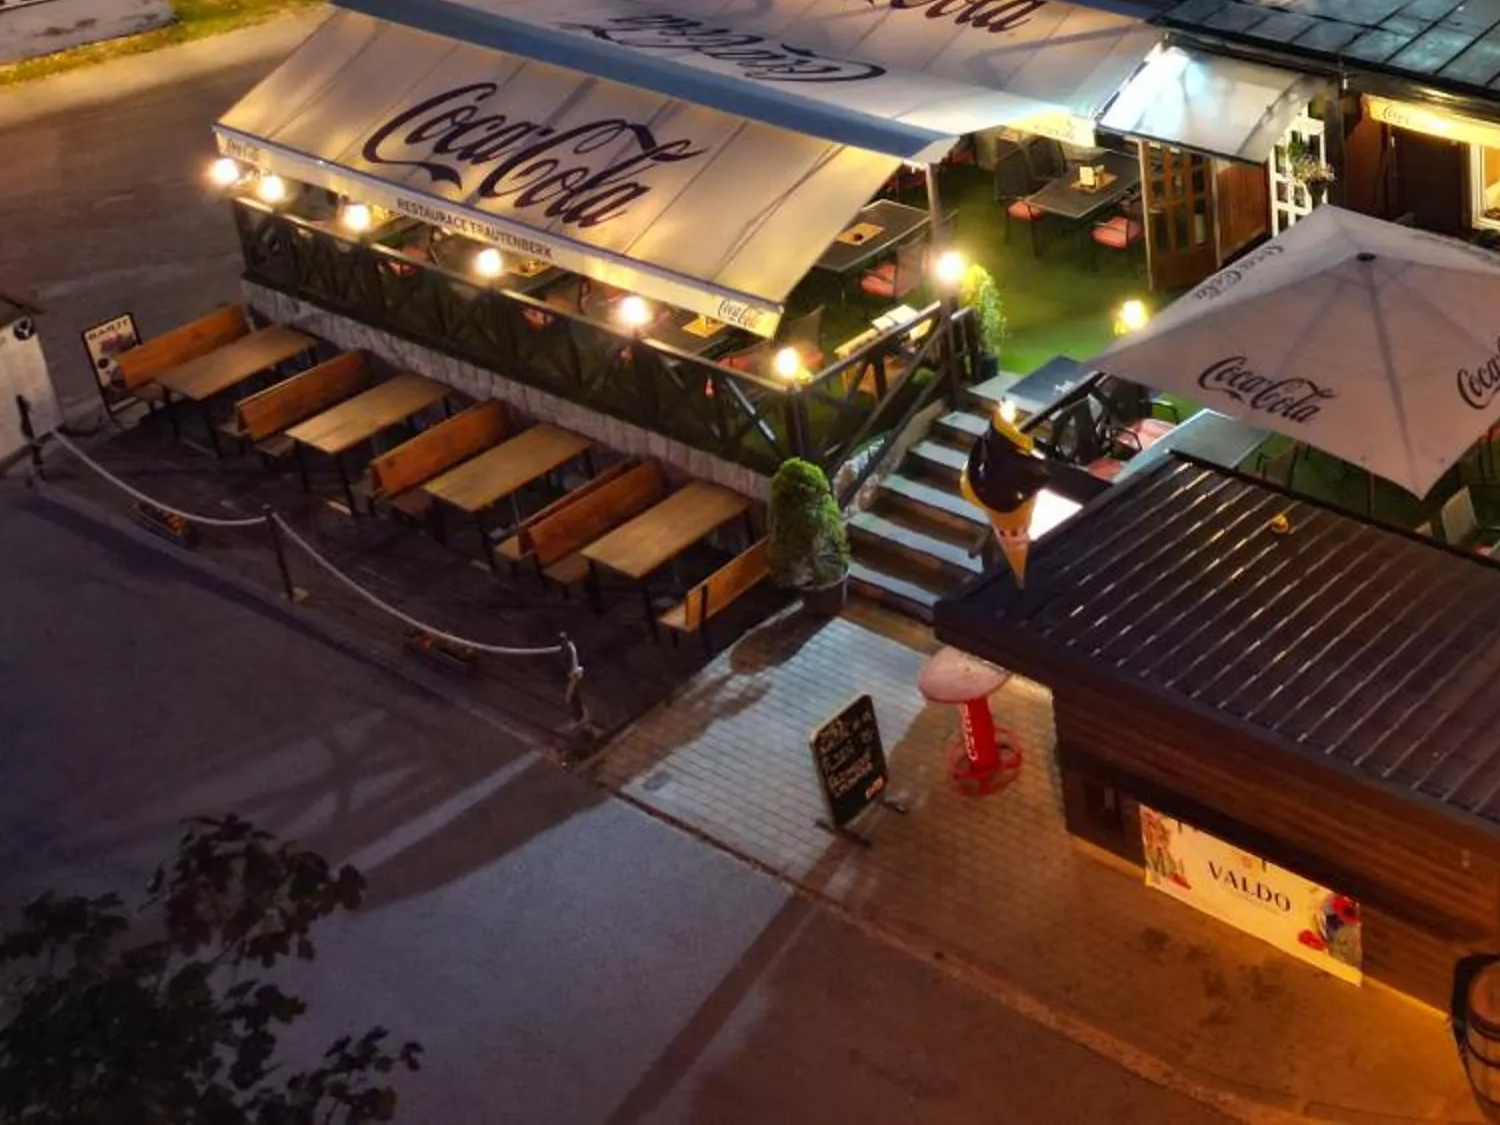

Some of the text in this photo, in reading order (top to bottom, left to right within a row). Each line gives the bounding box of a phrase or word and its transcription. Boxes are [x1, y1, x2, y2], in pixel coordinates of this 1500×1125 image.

[361, 81, 705, 229] Coca-Cola
[1198, 355, 1341, 424] Coca-Cola
[1208, 860, 1292, 912] VALDO
